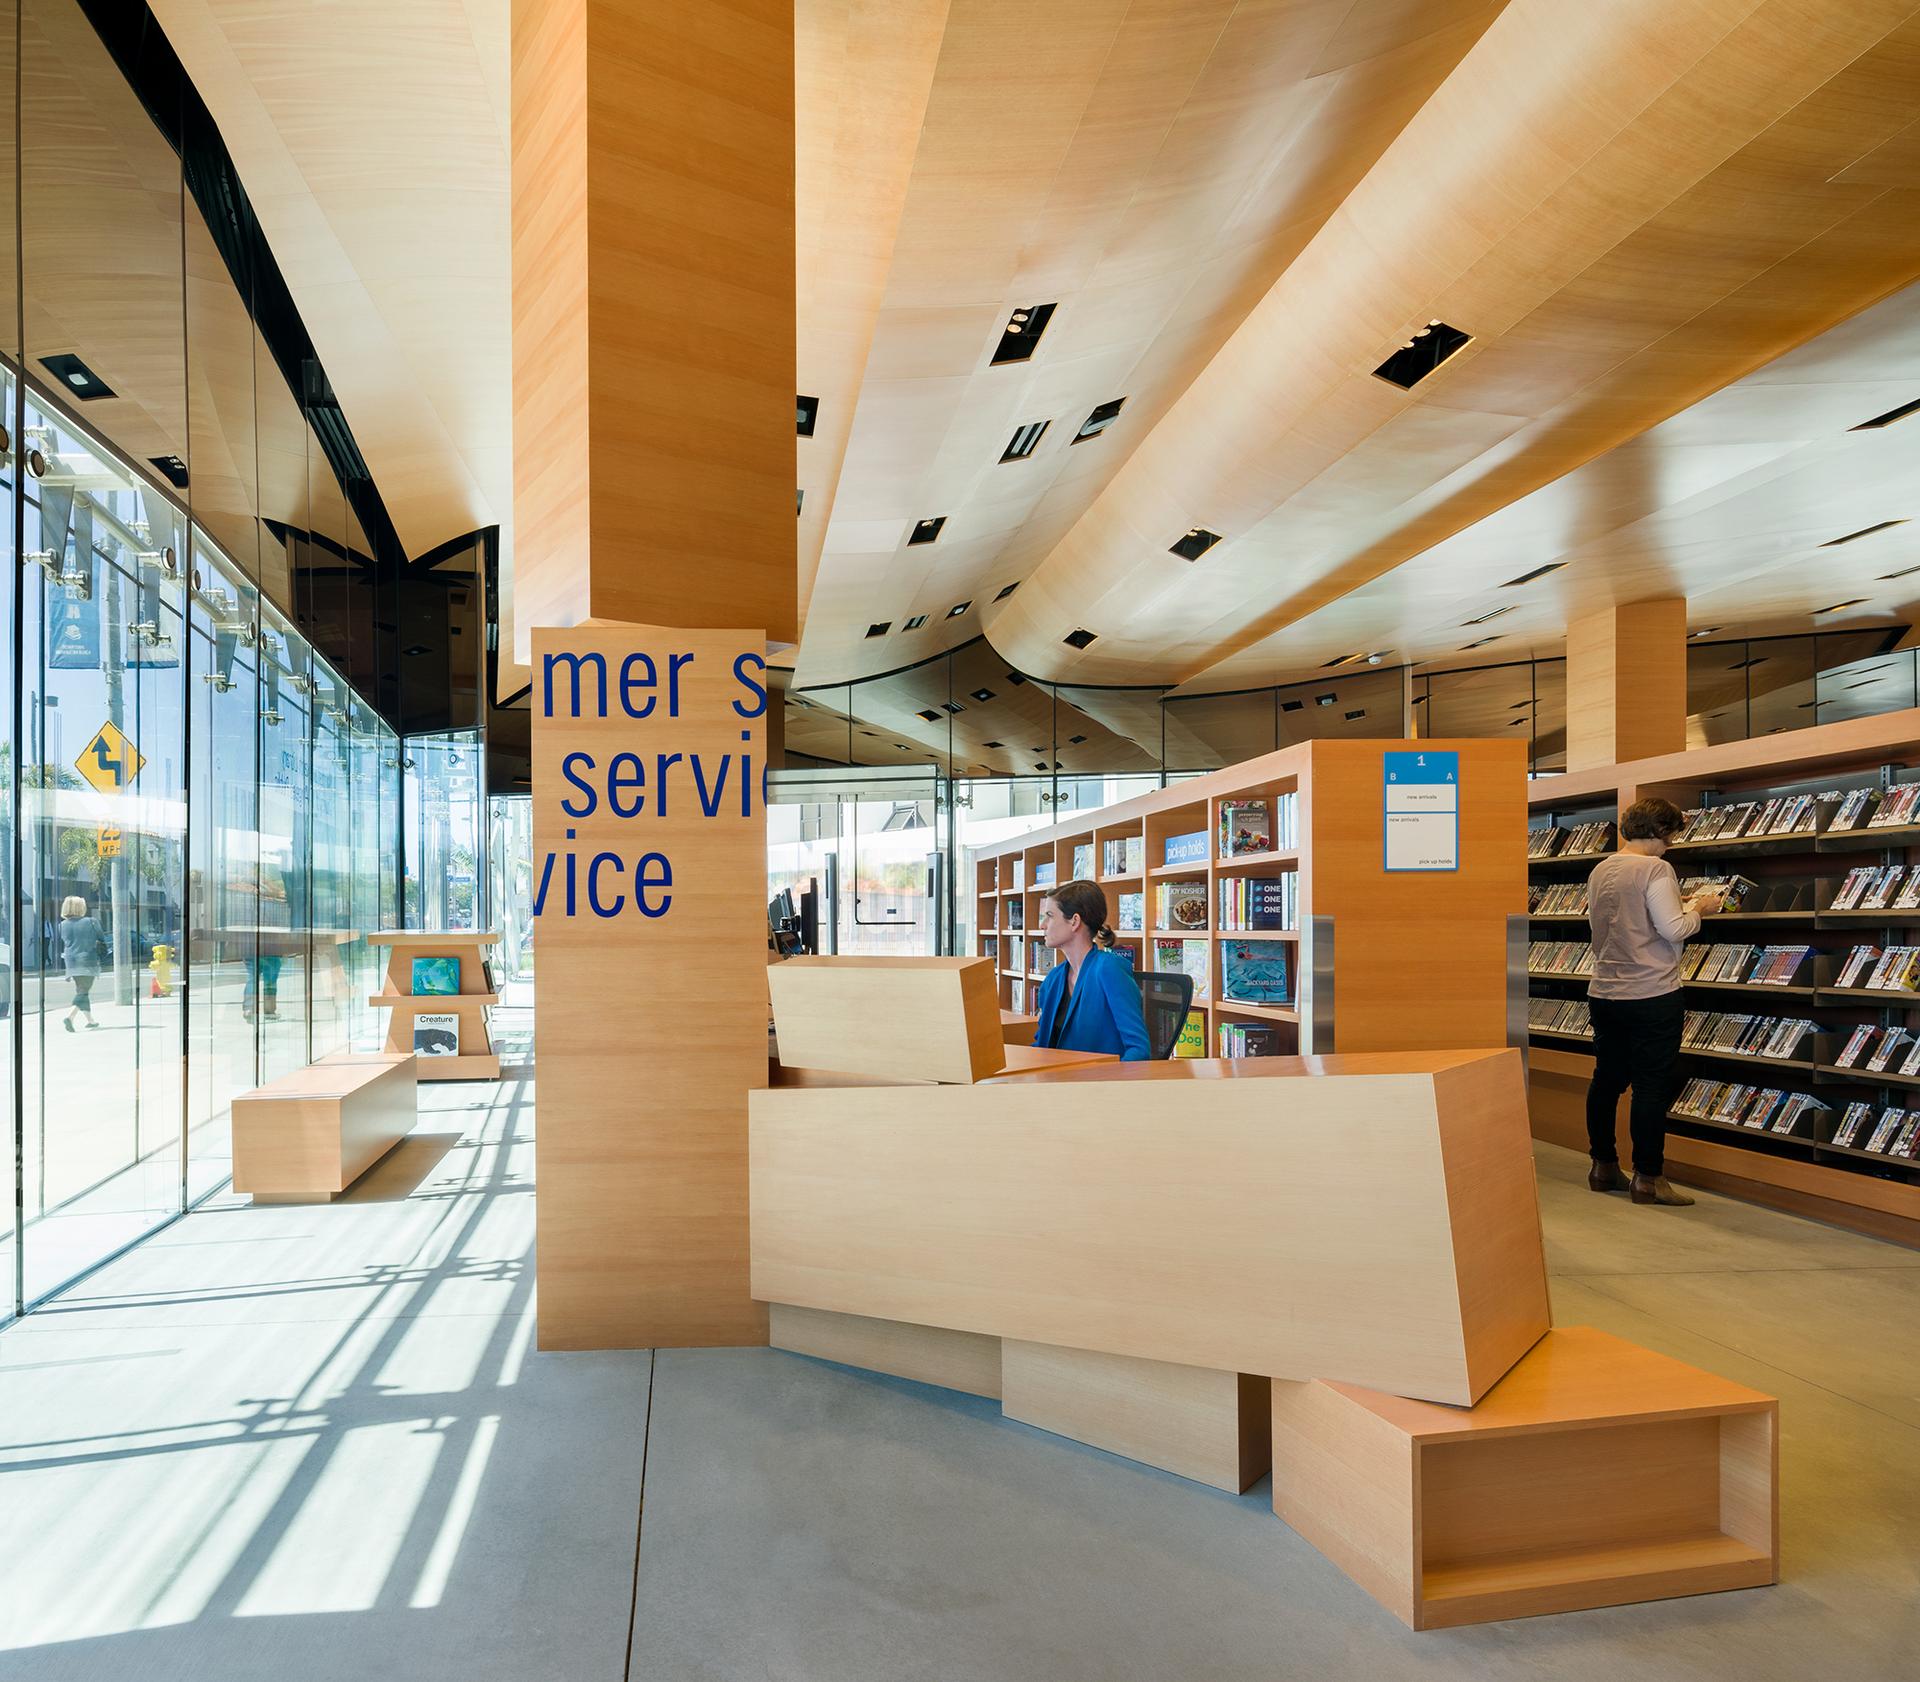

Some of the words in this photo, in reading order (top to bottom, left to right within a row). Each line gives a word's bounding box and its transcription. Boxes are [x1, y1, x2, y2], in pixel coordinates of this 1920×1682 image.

[543, 652, 694, 719] mer
[732, 652, 767, 719] s
[1417, 755, 1426, 766] 1
[560, 730, 767, 818] servi
[1390, 772, 1397, 781] B
[1446, 772, 1453, 781] A
[1188, 838, 1205, 857] holds
[1263, 885, 1281, 893] ONE
[1263, 895, 1281, 903] ONE
[420, 1015, 453, 1023] Creature
[1183, 1022, 1201, 1032] he
